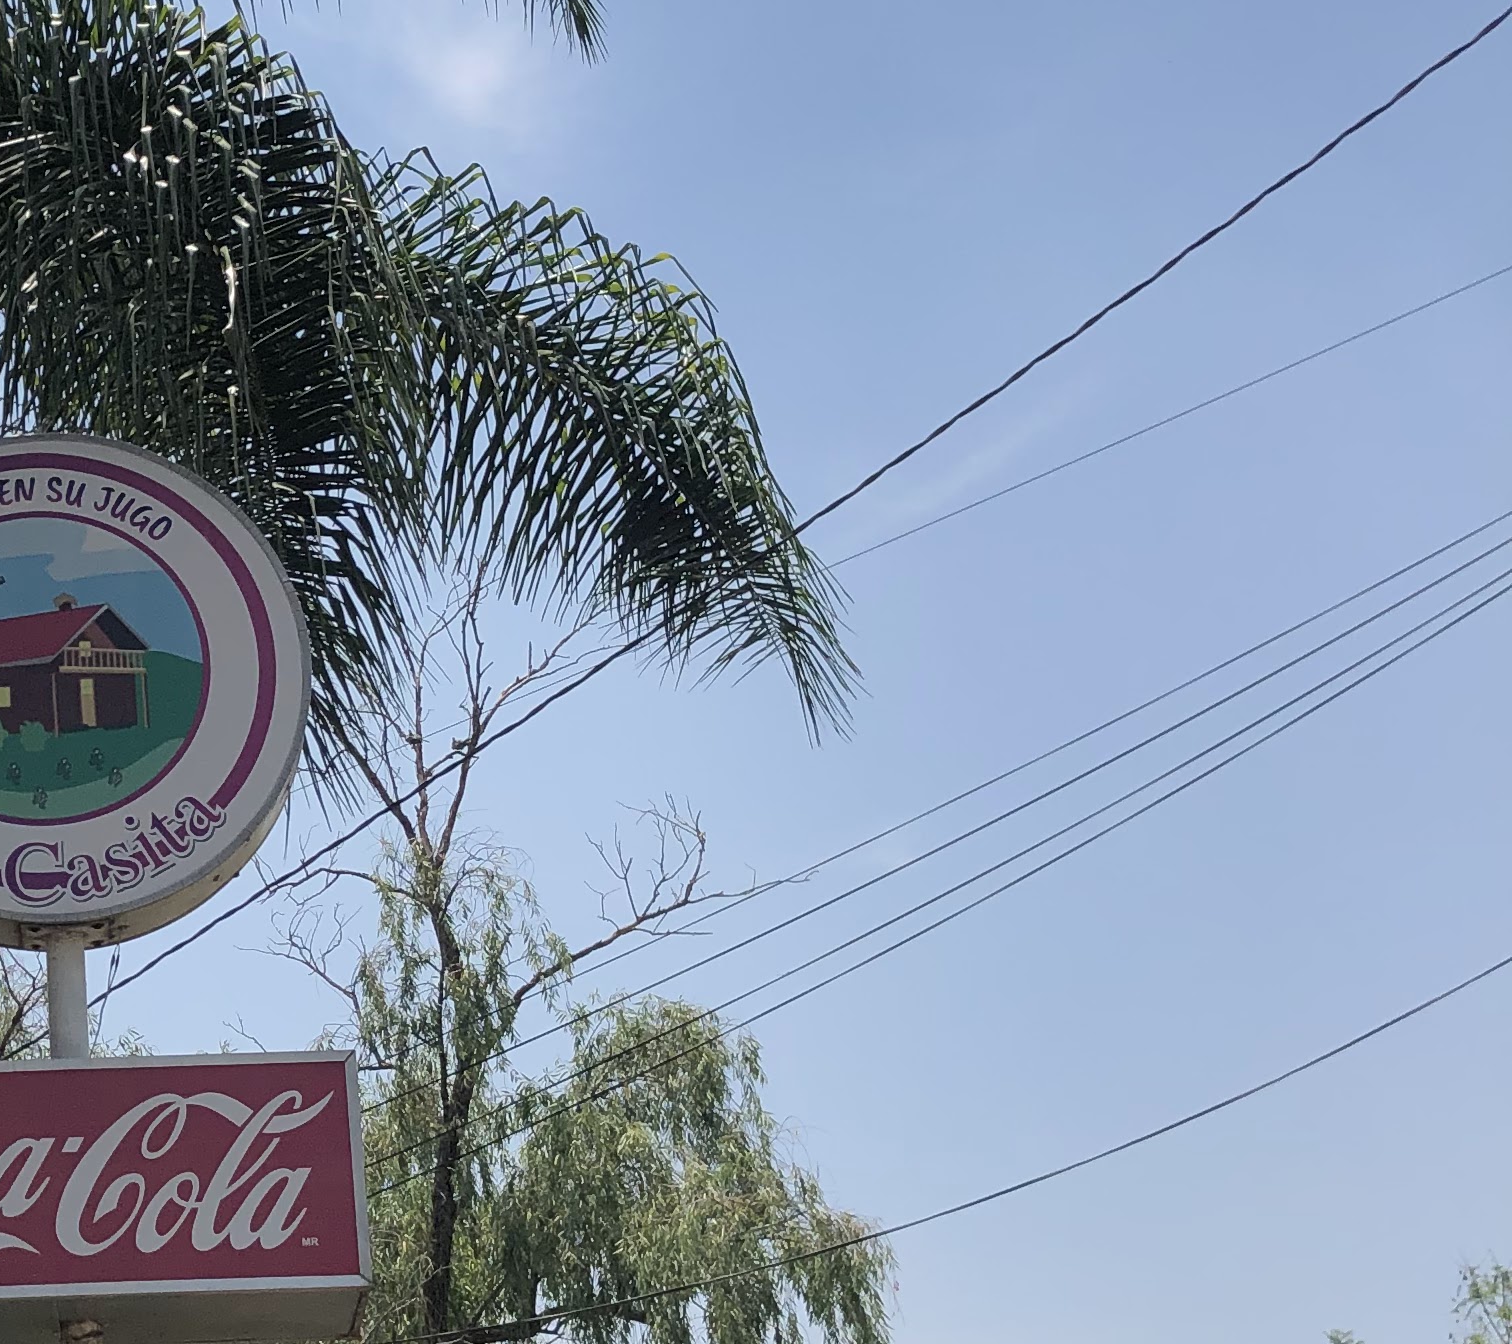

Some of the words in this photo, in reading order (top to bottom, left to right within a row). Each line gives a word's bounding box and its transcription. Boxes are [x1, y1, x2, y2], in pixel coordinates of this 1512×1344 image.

[45, 476, 87, 508] SU
[93, 485, 174, 541] JUGO
[3, 795, 227, 908] Casita
[301, 1236, 320, 1247] MR
